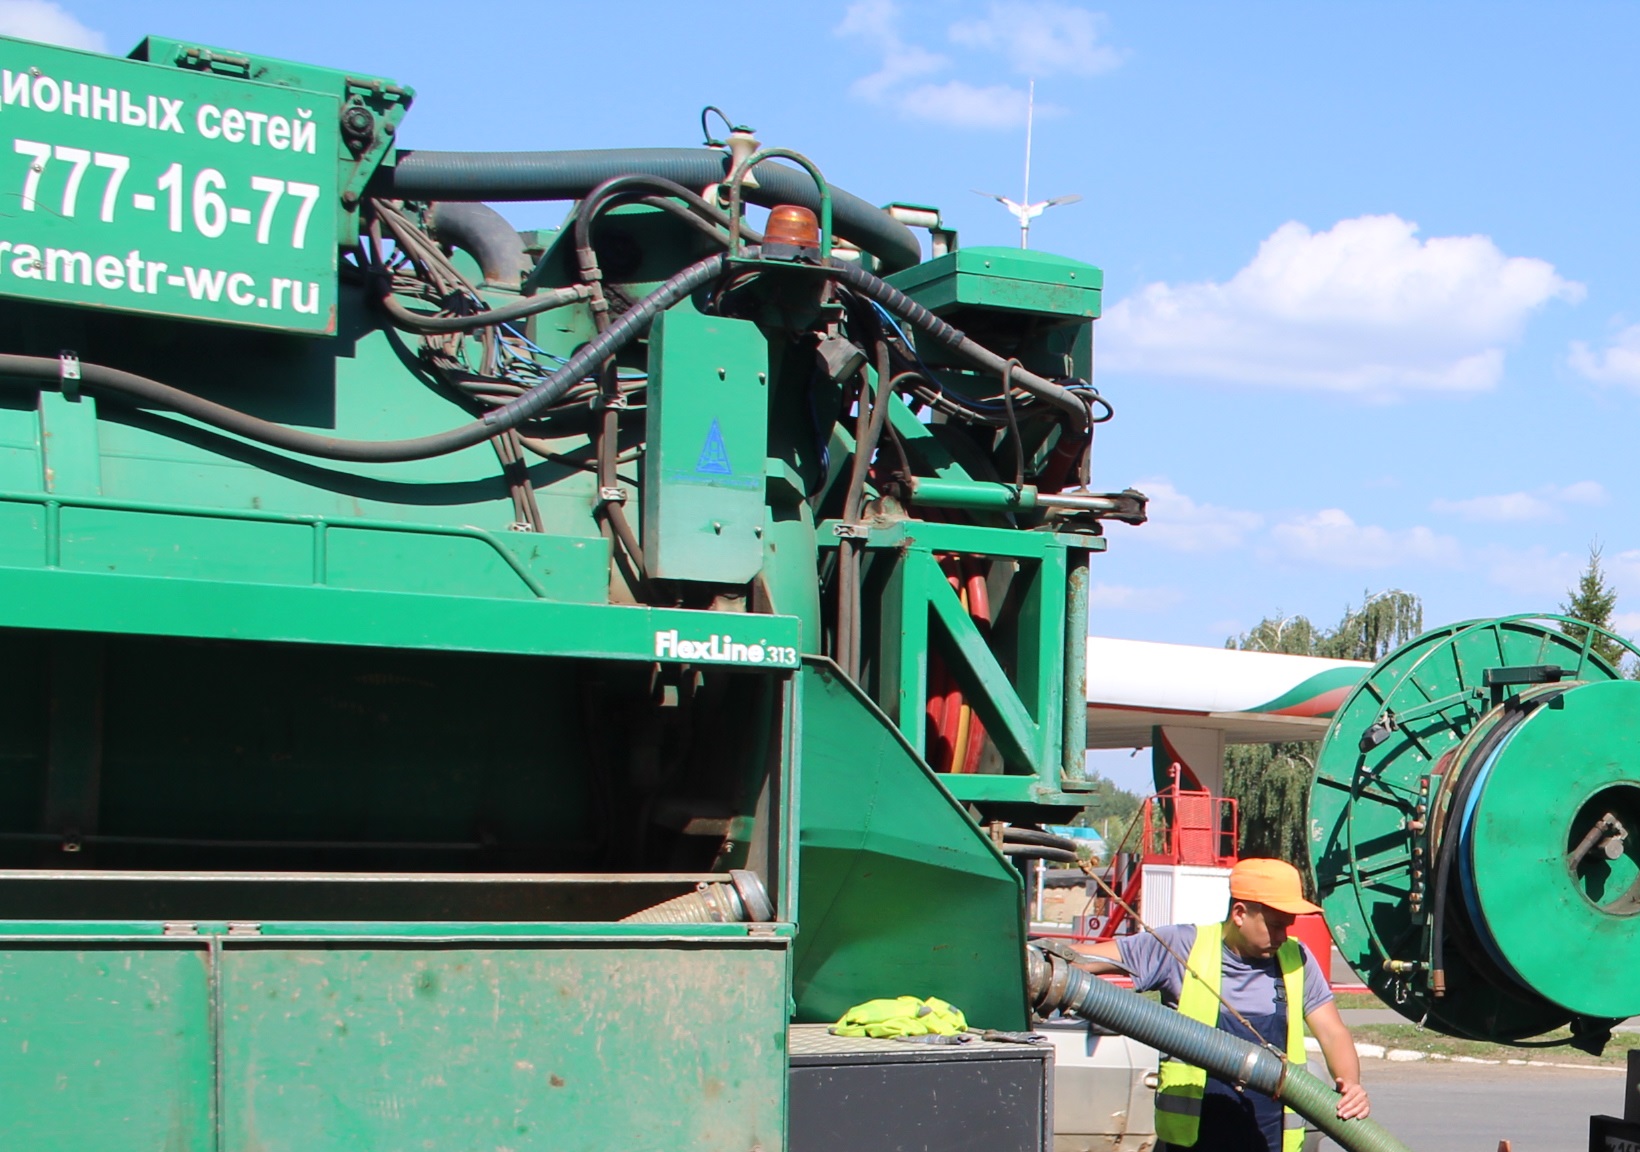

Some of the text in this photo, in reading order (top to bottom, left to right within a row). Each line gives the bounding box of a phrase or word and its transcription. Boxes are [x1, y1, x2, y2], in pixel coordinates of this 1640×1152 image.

[0, 69, 317, 154] ионных сетей
[14, 138, 320, 249] 777-16-77
[766, 646, 797, 665] 313
